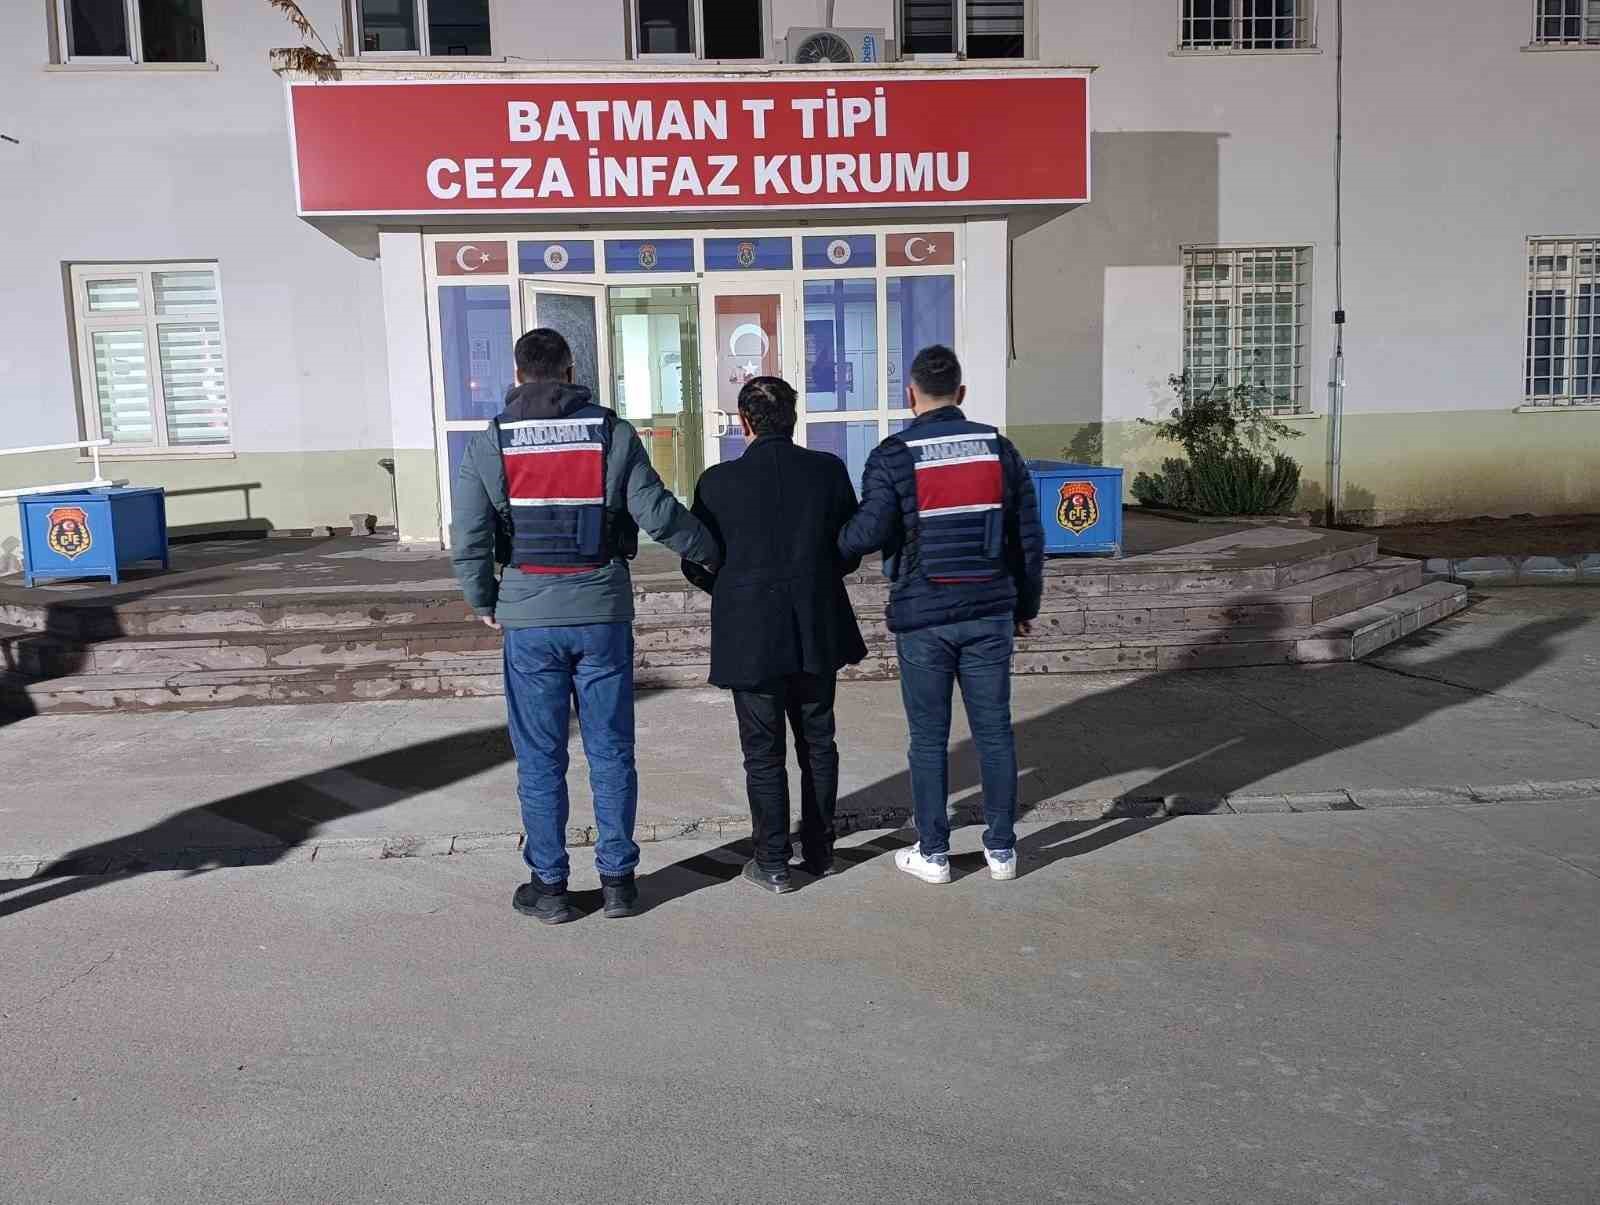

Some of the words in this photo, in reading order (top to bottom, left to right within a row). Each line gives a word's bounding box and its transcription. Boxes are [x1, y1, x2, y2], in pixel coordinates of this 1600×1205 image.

[507, 98, 728, 142] BATMAN
[742, 98, 775, 139] T
[791, 86, 887, 138] TİPİ
[426, 156, 575, 200] CEZA
[587, 147, 740, 198] İNFAZ
[753, 151, 970, 195] KURUMU
[510, 424, 591, 447] JANDARMA
[920, 440, 992, 461] JANDARMA
[1069, 506, 1088, 521] CTE
